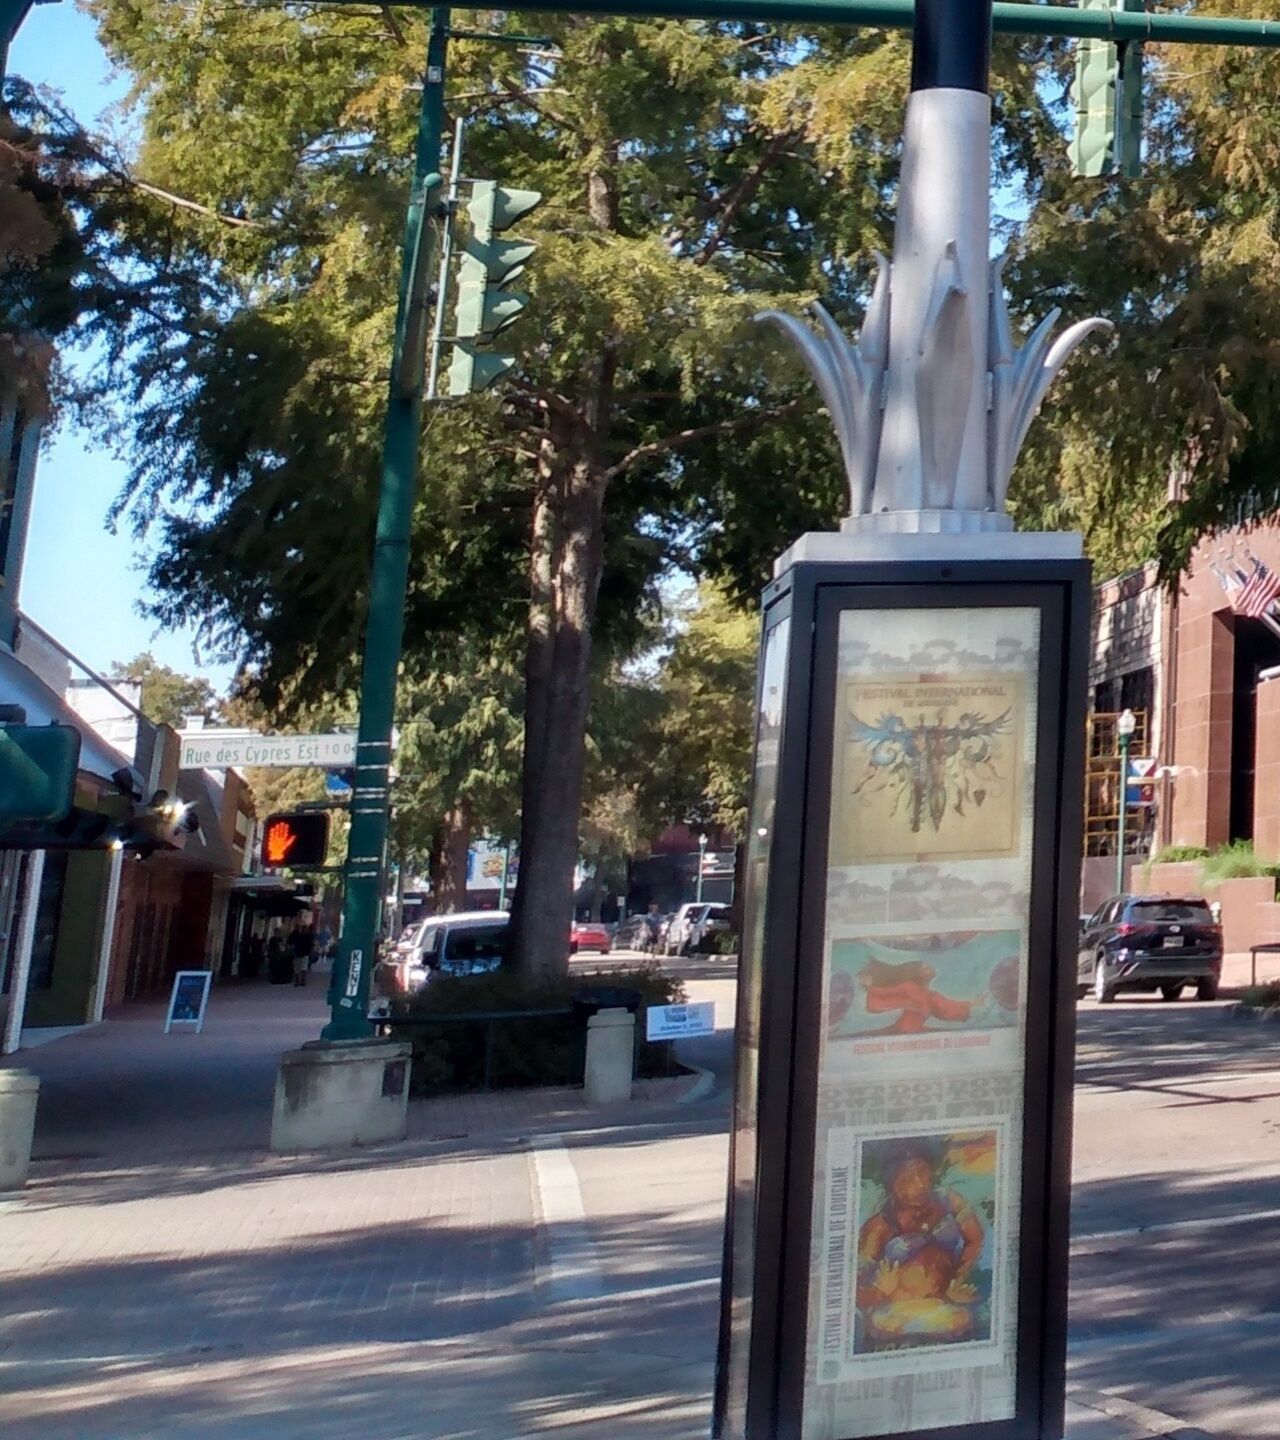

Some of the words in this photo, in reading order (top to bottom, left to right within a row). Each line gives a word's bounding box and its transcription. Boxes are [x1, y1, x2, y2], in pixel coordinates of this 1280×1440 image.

[185, 748, 210, 763] Rue
[216, 747, 239, 761] des
[298, 744, 319, 760] Est
[831, 1166, 848, 1215] LOUISIANE
[829, 1217, 846, 1232] DE
[825, 1234, 846, 1308] INTERNATIONAL
[823, 1310, 843, 1354] FESTIVAL
